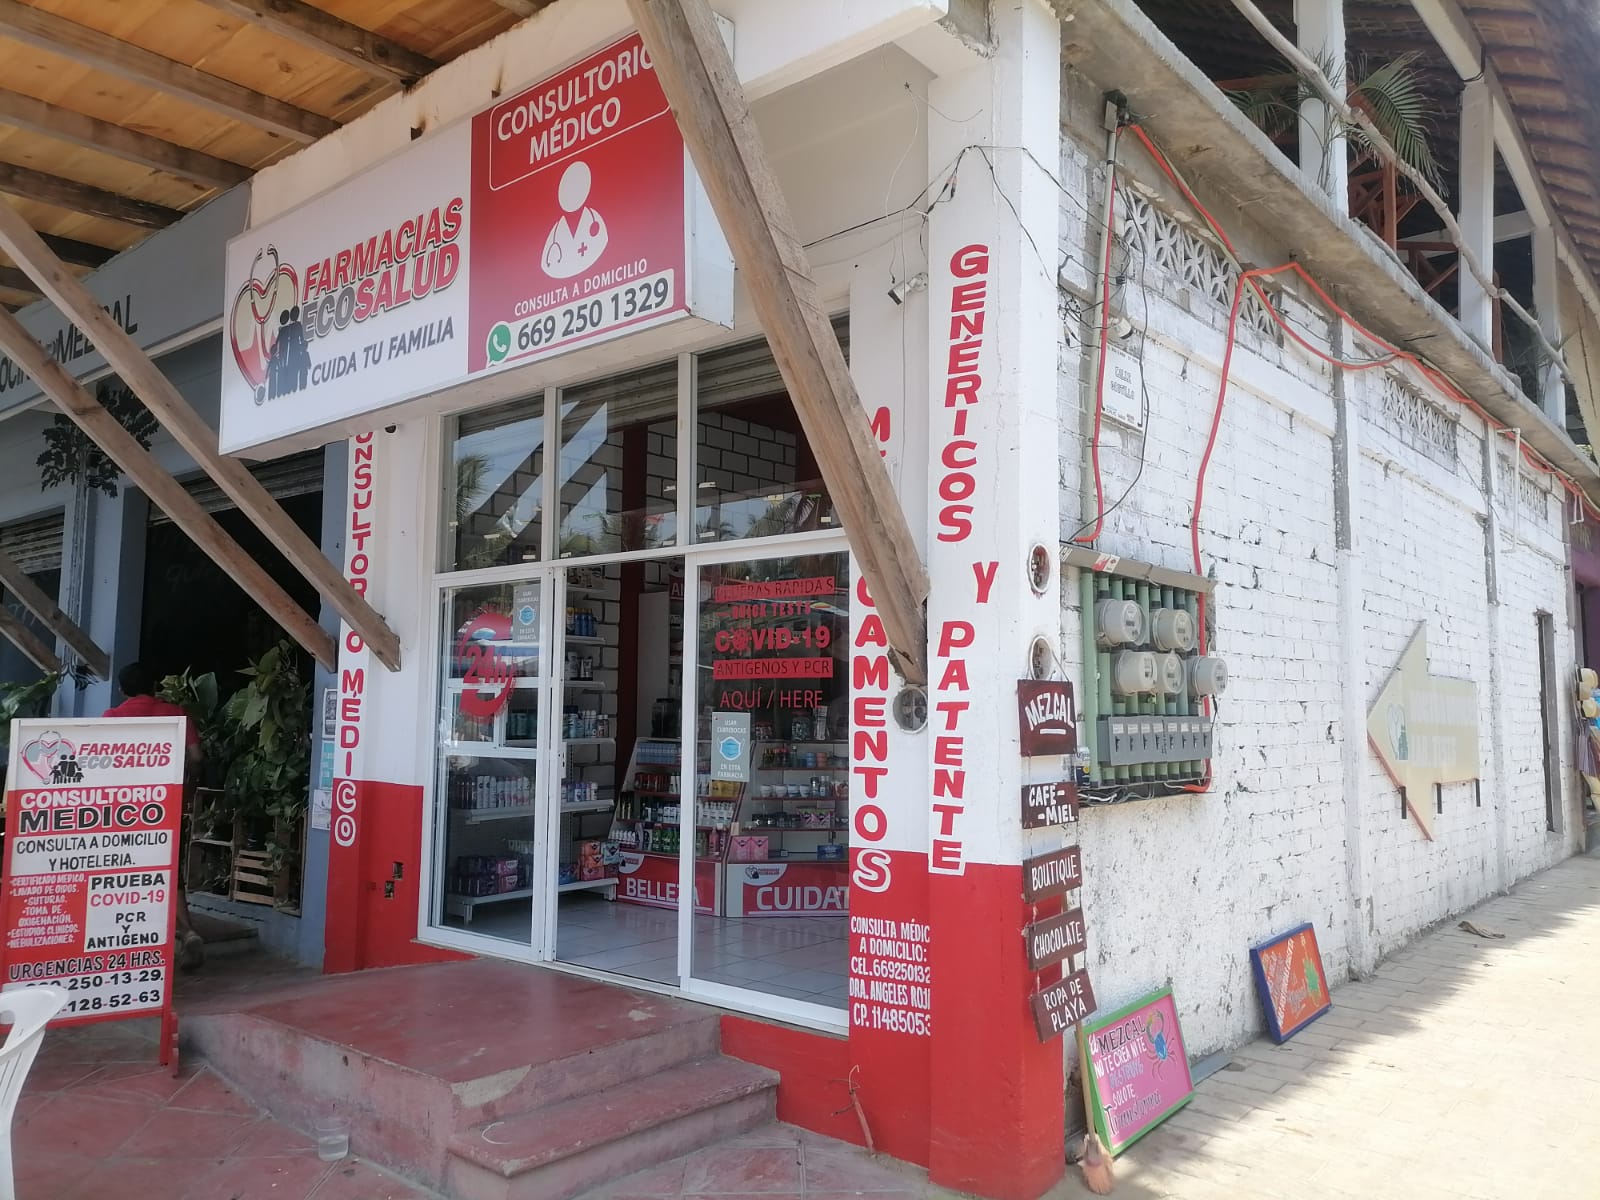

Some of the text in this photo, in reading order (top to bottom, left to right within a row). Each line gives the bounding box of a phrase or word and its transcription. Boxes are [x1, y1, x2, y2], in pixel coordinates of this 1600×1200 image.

[529, 97, 621, 165] MÉDICO
[302, 197, 464, 304] FARMACIAS
[302, 243, 460, 342] ECOSALUD
[515, 258, 648, 316] CONSULTA A DOMICILIO
[518, 277, 669, 350] 669 250 1329
[311, 316, 454, 386] CUIDA TU FAMILIA
[972, 561, 999, 603] Y
[772, 600, 812, 617] TESTS
[714, 624, 831, 652] COVID-19
[717, 660, 830, 675] ANTIGENOS Y PCR
[720, 686, 762, 710] AQUÍ
[780, 690, 823, 708] HERE
[1025, 692, 1075, 731] MEZCAL
[78, 742, 172, 756] FARMACIAS
[930, 620, 976, 872] PATENTE
[78, 754, 171, 769] ECOSALUD
[20, 785, 167, 810] CONSULTORIO
[19, 803, 165, 834] MEDICO
[16, 832, 168, 854] CONSULTA A DOMICILIO
[49, 853, 136, 873] Y HOTELERIA.
[1032, 854, 1079, 891] BOUTIQUE
[91, 872, 166, 890] PRUEBA
[25, 904, 62, 916] TOMA DE
[90, 890, 165, 907] COVID-19
[115, 912, 147, 924] PCR
[121, 925, 130, 934] Y
[850, 916, 897, 939] CONSULTA
[87, 932, 159, 949] ANTIGENO
[859, 936, 927, 962] A DOMICILIO:
[1033, 920, 1083, 960] CHOCOLATE
[10, 950, 165, 980] URGENCIAS 24 HRS.
[849, 978, 869, 999] DRA.
[870, 980, 908, 1005] ANGELES
[1043, 977, 1083, 1011] ROPA DE
[1051, 997, 1087, 1032] PLAYA
[1098, 1015, 1147, 1057] MEZCAL
[1093, 1058, 1105, 1079] NO
[1104, 1053, 1115, 1075] TE
